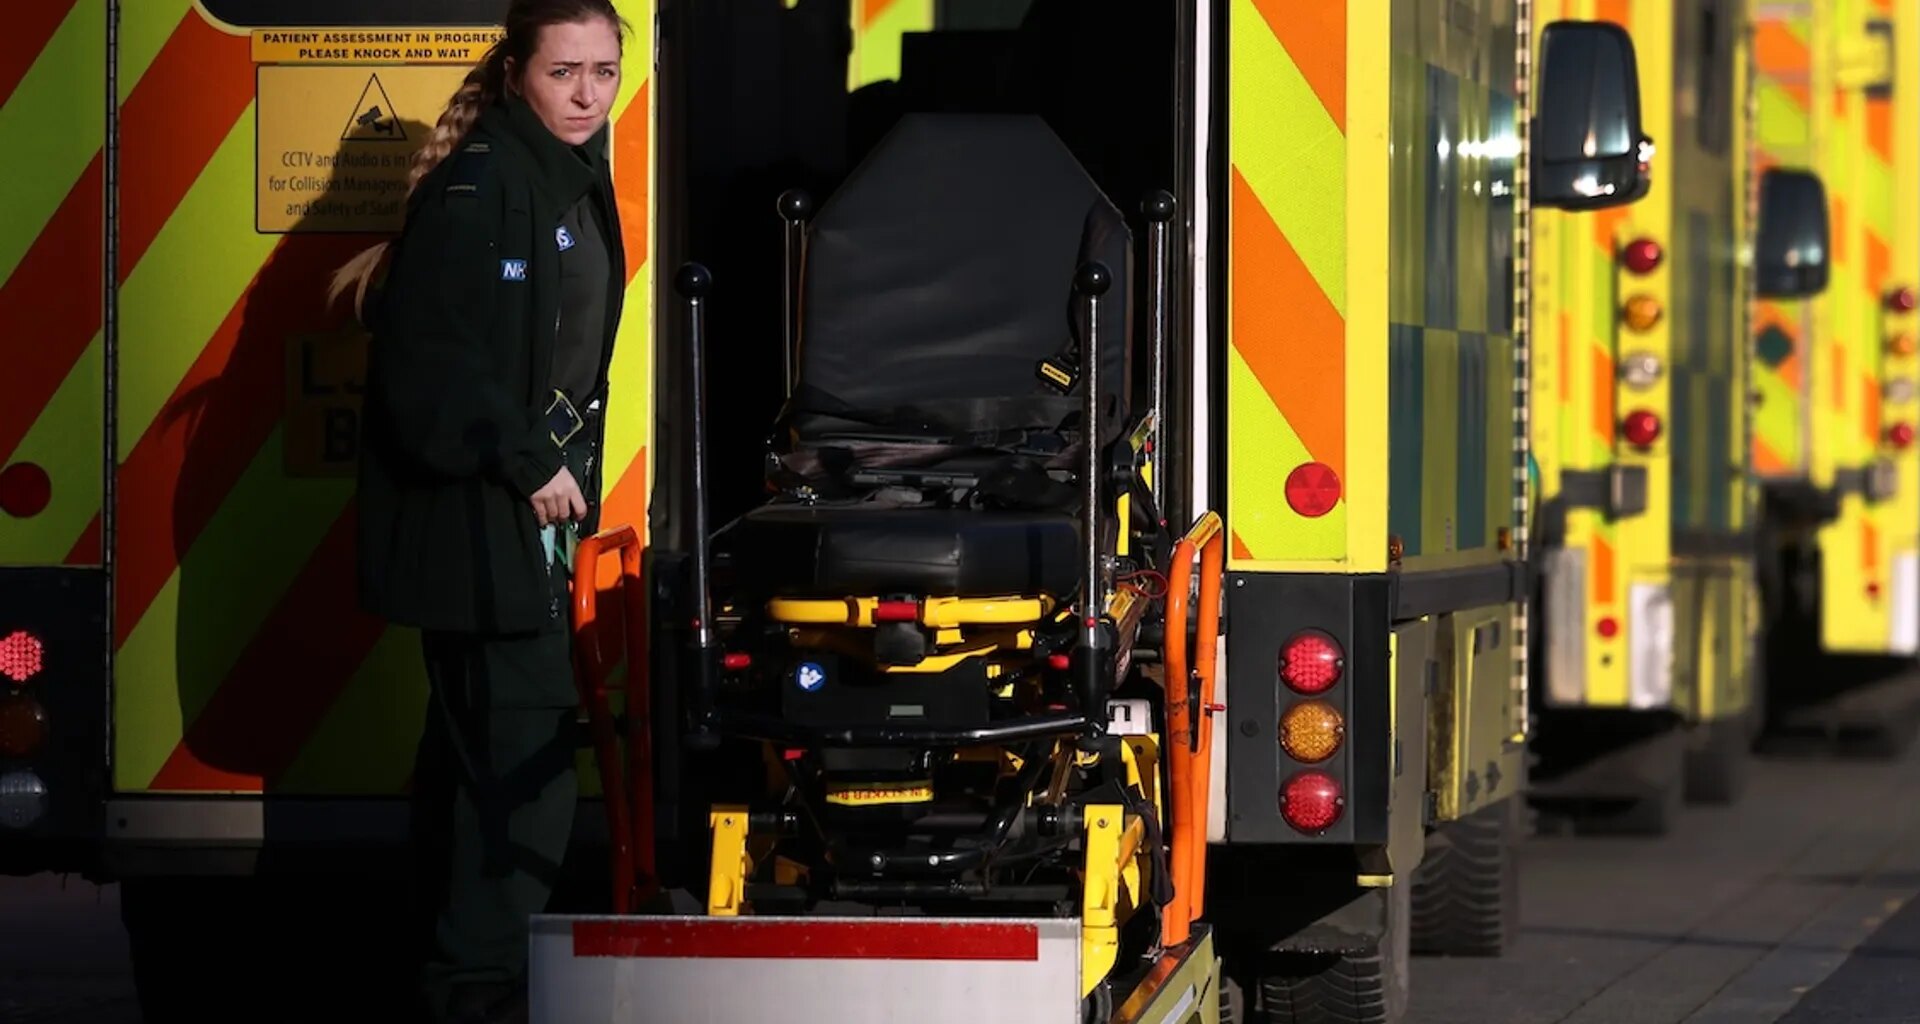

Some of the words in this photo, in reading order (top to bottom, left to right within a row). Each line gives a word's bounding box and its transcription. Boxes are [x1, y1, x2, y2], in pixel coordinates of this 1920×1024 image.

[263, 33, 318, 43] PATIENT
[324, 33, 411, 43] ASSESSMENT
[416, 33, 430, 43] IN
[299, 49, 349, 59] PLEASE
[354, 49, 400, 59] KNOCK
[405, 49, 432, 59] AND
[437, 49, 469, 59] WAIT
[282, 152, 312, 168] CCTV
[315, 151, 337, 168] and
[342, 152, 377, 167] Audio
[381, 152, 391, 167] is
[394, 152, 406, 167] in
[269, 178, 286, 193] for
[290, 178, 340, 193] Collision
[286, 202, 309, 217] and
[312, 202, 350, 218] Safety
[354, 202, 367, 216] of
[369, 202, 399, 216] Staff
